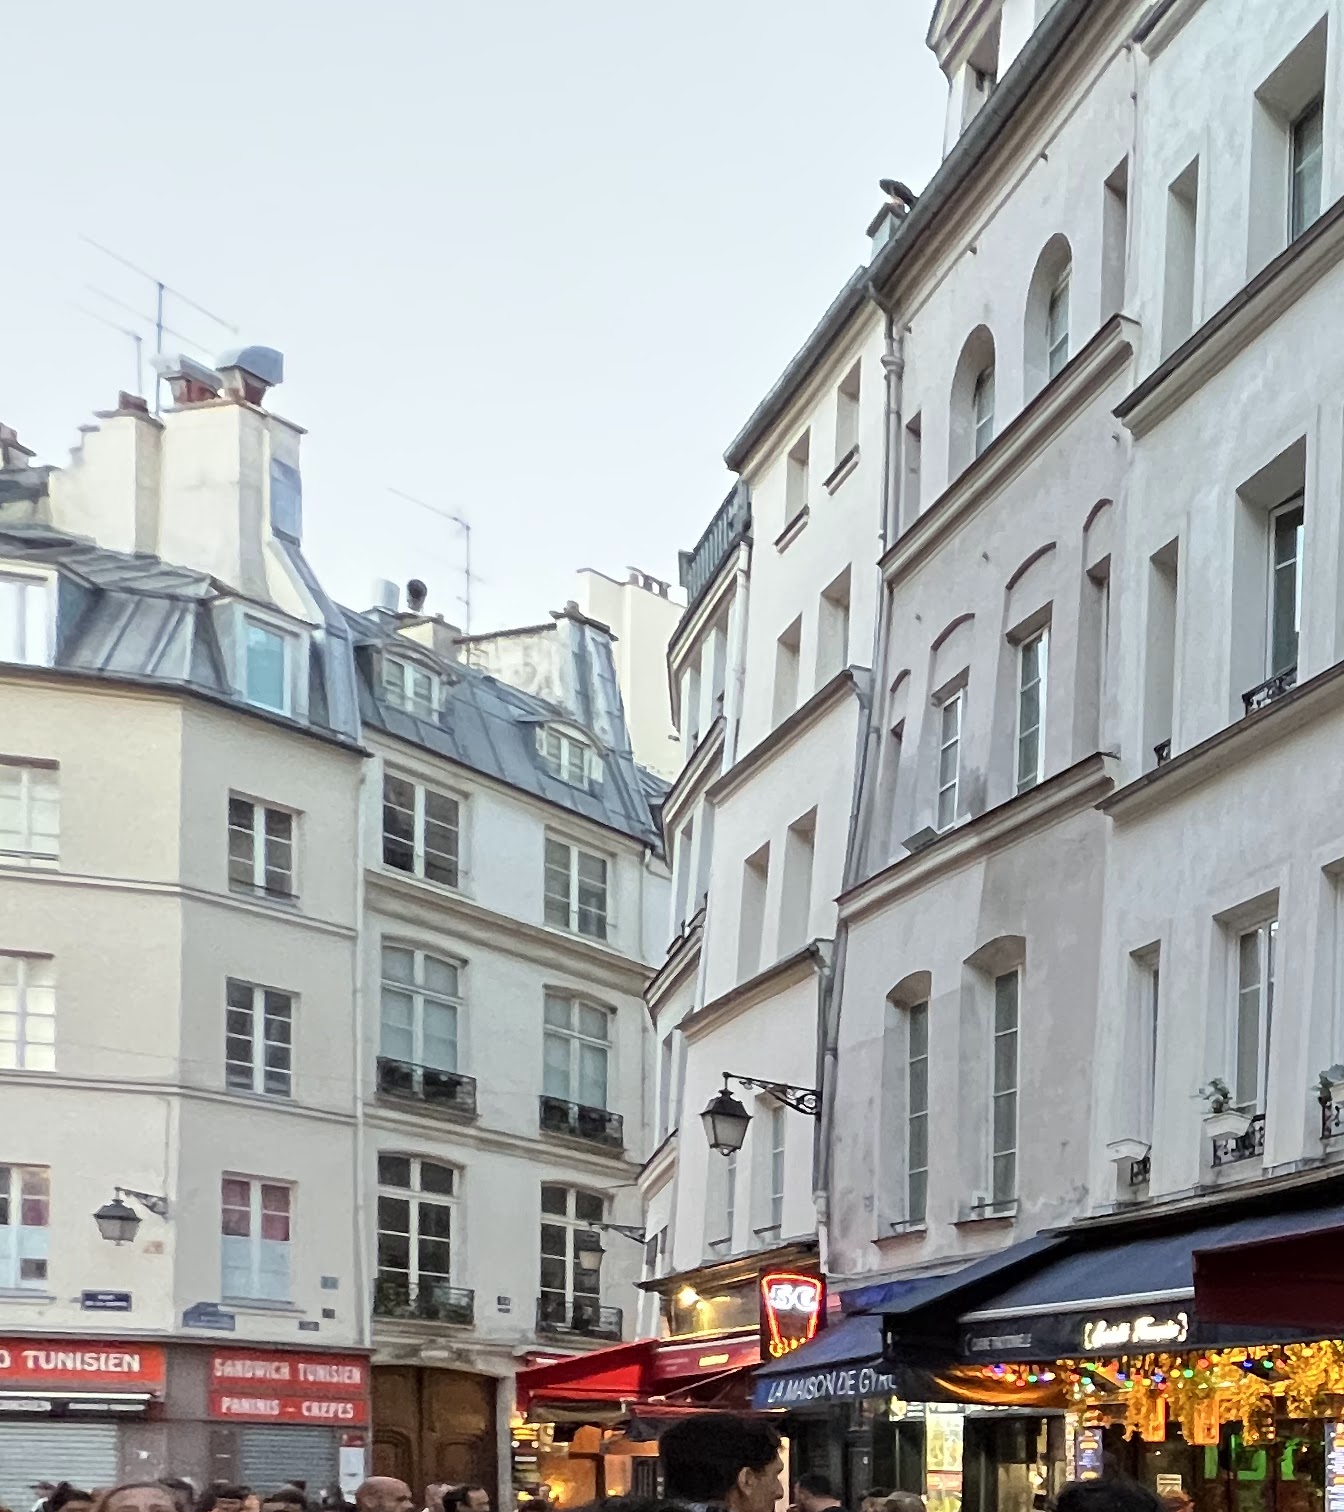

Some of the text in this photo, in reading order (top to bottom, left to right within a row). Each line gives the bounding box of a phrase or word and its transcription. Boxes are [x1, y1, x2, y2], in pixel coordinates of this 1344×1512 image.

[21, 1350, 141, 1373] TUNISIEN
[214, 1358, 361, 1384] SANDWICH TUNISIEN
[784, 1370, 837, 1401] MAISON
[837, 1369, 857, 1395] DE
